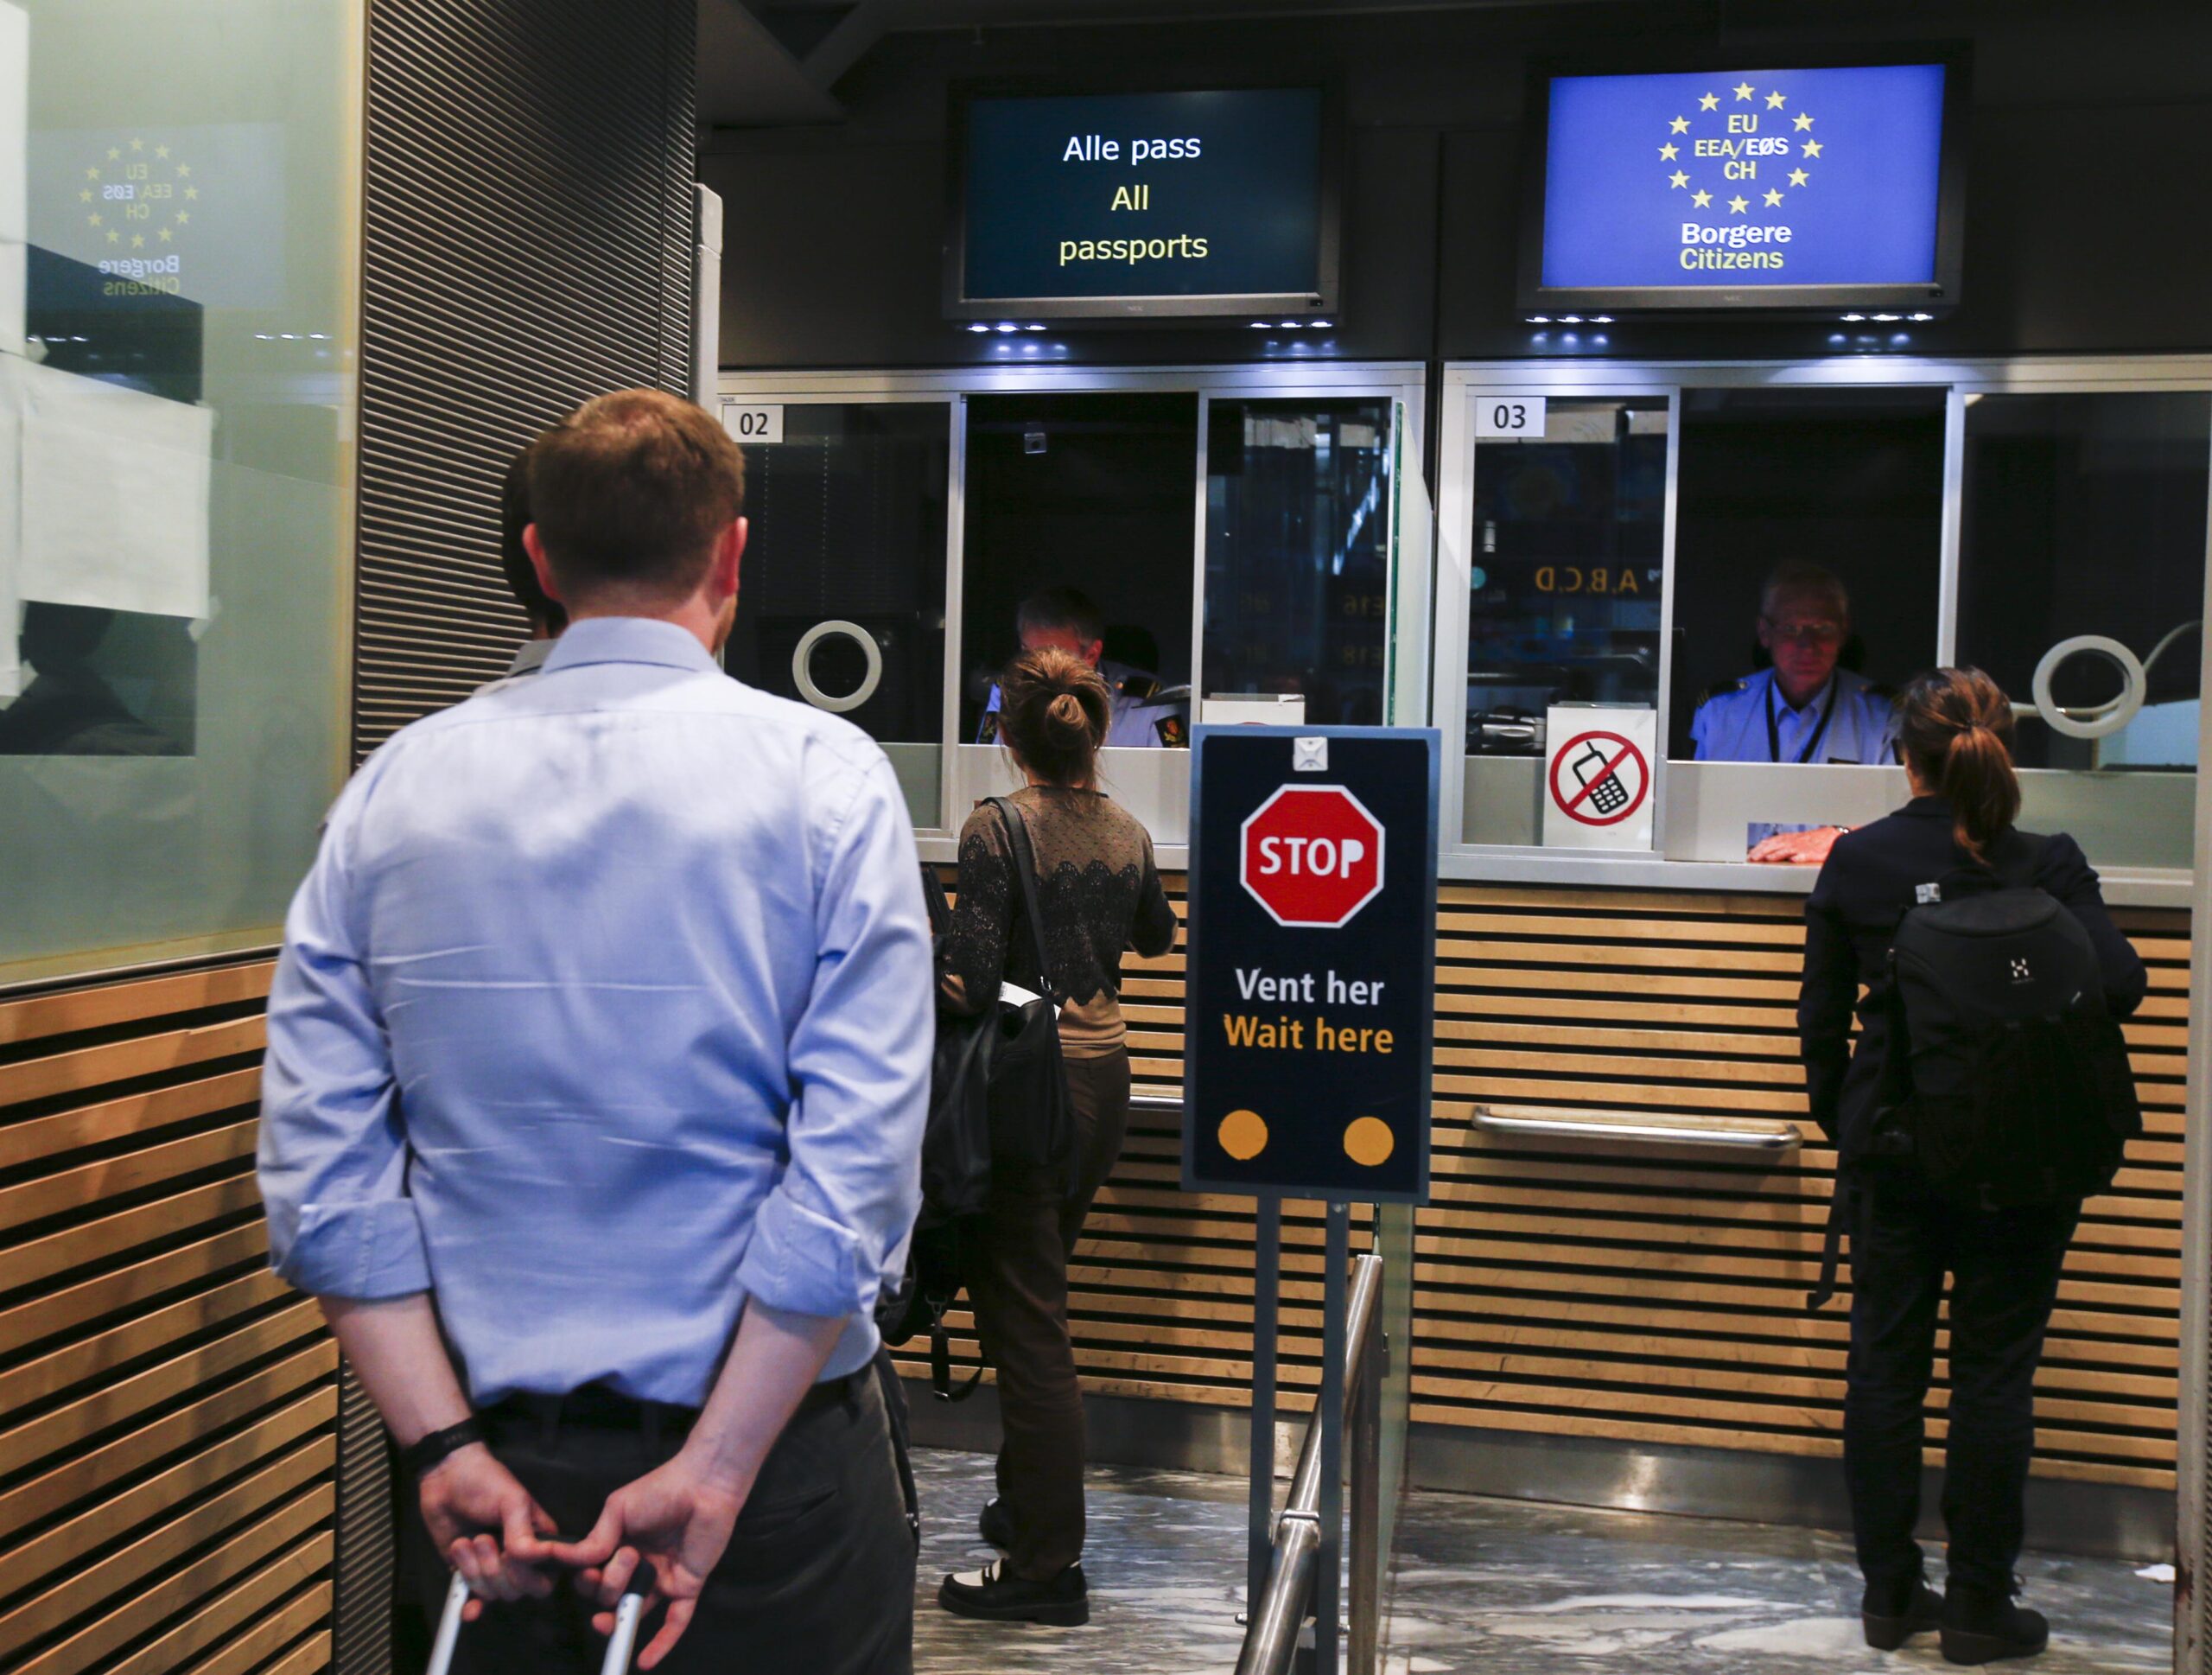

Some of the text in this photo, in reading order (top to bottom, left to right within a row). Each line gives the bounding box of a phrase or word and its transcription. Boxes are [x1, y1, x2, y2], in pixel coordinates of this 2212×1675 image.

[1728, 113, 1758, 134] EU
[1063, 135, 1201, 166] Alle pass
[1694, 137, 1789, 160] EEA/EØS
[1724, 161, 1757, 180] CH
[1110, 184, 1149, 211] All
[1681, 222, 1793, 249] Borgere
[1059, 234, 1209, 266] passports
[1680, 247, 1784, 270] Citizens
[740, 412, 768, 436] 02
[1494, 404, 1526, 429] 03
[1260, 836, 1364, 879] STOP
[1235, 967, 1385, 1005] Vent her
[1224, 1014, 1394, 1054] Wait here
